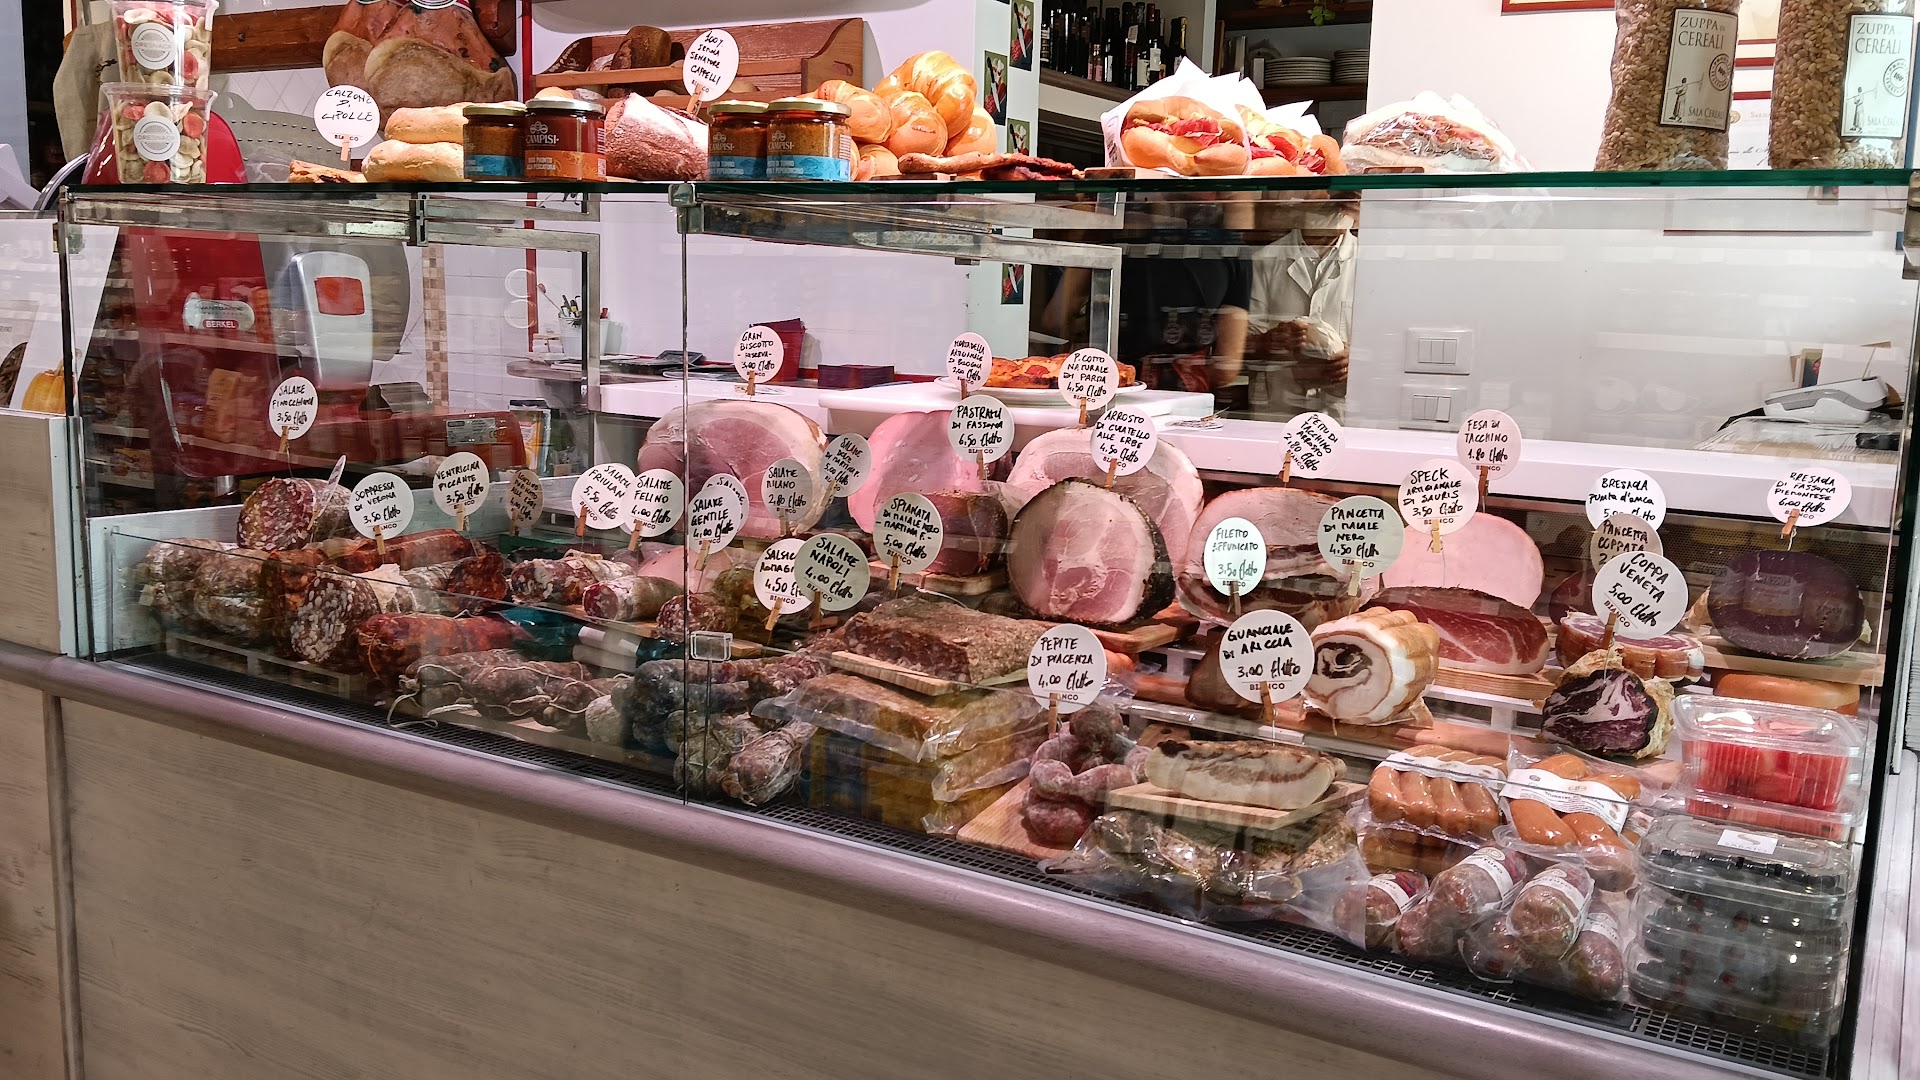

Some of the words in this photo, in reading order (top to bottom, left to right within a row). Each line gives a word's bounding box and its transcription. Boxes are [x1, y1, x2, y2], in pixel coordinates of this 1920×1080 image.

[1680, 17, 1717, 30] ZUPPA
[1856, 23, 1894, 35] ZUPPA
[1678, 31, 1724, 49] CEREALI
[1855, 37, 1901, 54] CEREALI
[690, 64, 721, 84] CAPPELLI
[691, 79, 709, 92] BICO
[321, 110, 372, 121] CIPOLLE
[526, 134, 556, 144] CAMPISI
[768, 141, 792, 149] CAMPISI
[741, 331, 761, 341] GRAN
[739, 340, 773, 351] BISCOTTO
[1067, 363, 1108, 374] NATURALE
[1104, 410, 1144, 423] ARROSTO
[951, 421, 960, 429] DI
[1095, 421, 1104, 430] DI
[1108, 424, 1149, 440] CULATELLO
[1467, 419, 1487, 431] FESA
[1096, 432, 1115, 441] ALLE
[1119, 436, 1143, 449] ERBE
[1295, 430, 1323, 457] ARROSTO
[1300, 421, 1332, 454] TACCHINO
[1328, 432, 1338, 443] DI
[1464, 432, 1507, 443] TACCHINO
[767, 466, 799, 479] SALAME
[1410, 467, 1449, 485] SPECK
[438, 474, 477, 491] PICCANTE
[636, 474, 673, 491] SALAME
[766, 480, 796, 489] MILANO
[1406, 480, 1461, 496] ARTIGIANALE
[1600, 477, 1648, 491] BRESAOLA
[354, 481, 395, 501] SOPPRESSA
[366, 491, 396, 505] VERONA
[632, 489, 669, 505] FELINO
[1421, 490, 1458, 503] SAURIS
[1774, 487, 1831, 501] PIEMONTESE
[691, 496, 723, 514] SALAME
[890, 498, 931, 523] SPIANATA
[363, 512, 381, 524] 3,50
[690, 508, 728, 527] GENTILE
[893, 513, 920, 528] MAIALE
[1330, 506, 1385, 521] PANCETTA
[1215, 527, 1248, 539] FILETTO
[1323, 523, 1335, 533] DI
[1341, 522, 1378, 531] MAIALE
[882, 534, 903, 549] 5,00
[1335, 533, 1365, 543] NERO
[815, 536, 860, 568] SALAME
[809, 549, 850, 579] NAPOLI
[1217, 562, 1237, 576] 3,50
[1629, 552, 1669, 585] COPPA
[1618, 561, 1665, 604] VENETA
[1607, 581, 1632, 605] 5,00
[1227, 623, 1293, 642] GUANCIALE
[1039, 636, 1078, 652] PEPITE
[1222, 650, 1235, 660] DI
[1240, 636, 1292, 655] ARICCIA
[1030, 655, 1041, 667] DI
[1046, 653, 1093, 666] PIACENZA
[1237, 663, 1263, 678] 3,00
[1037, 673, 1061, 689] 4,00
